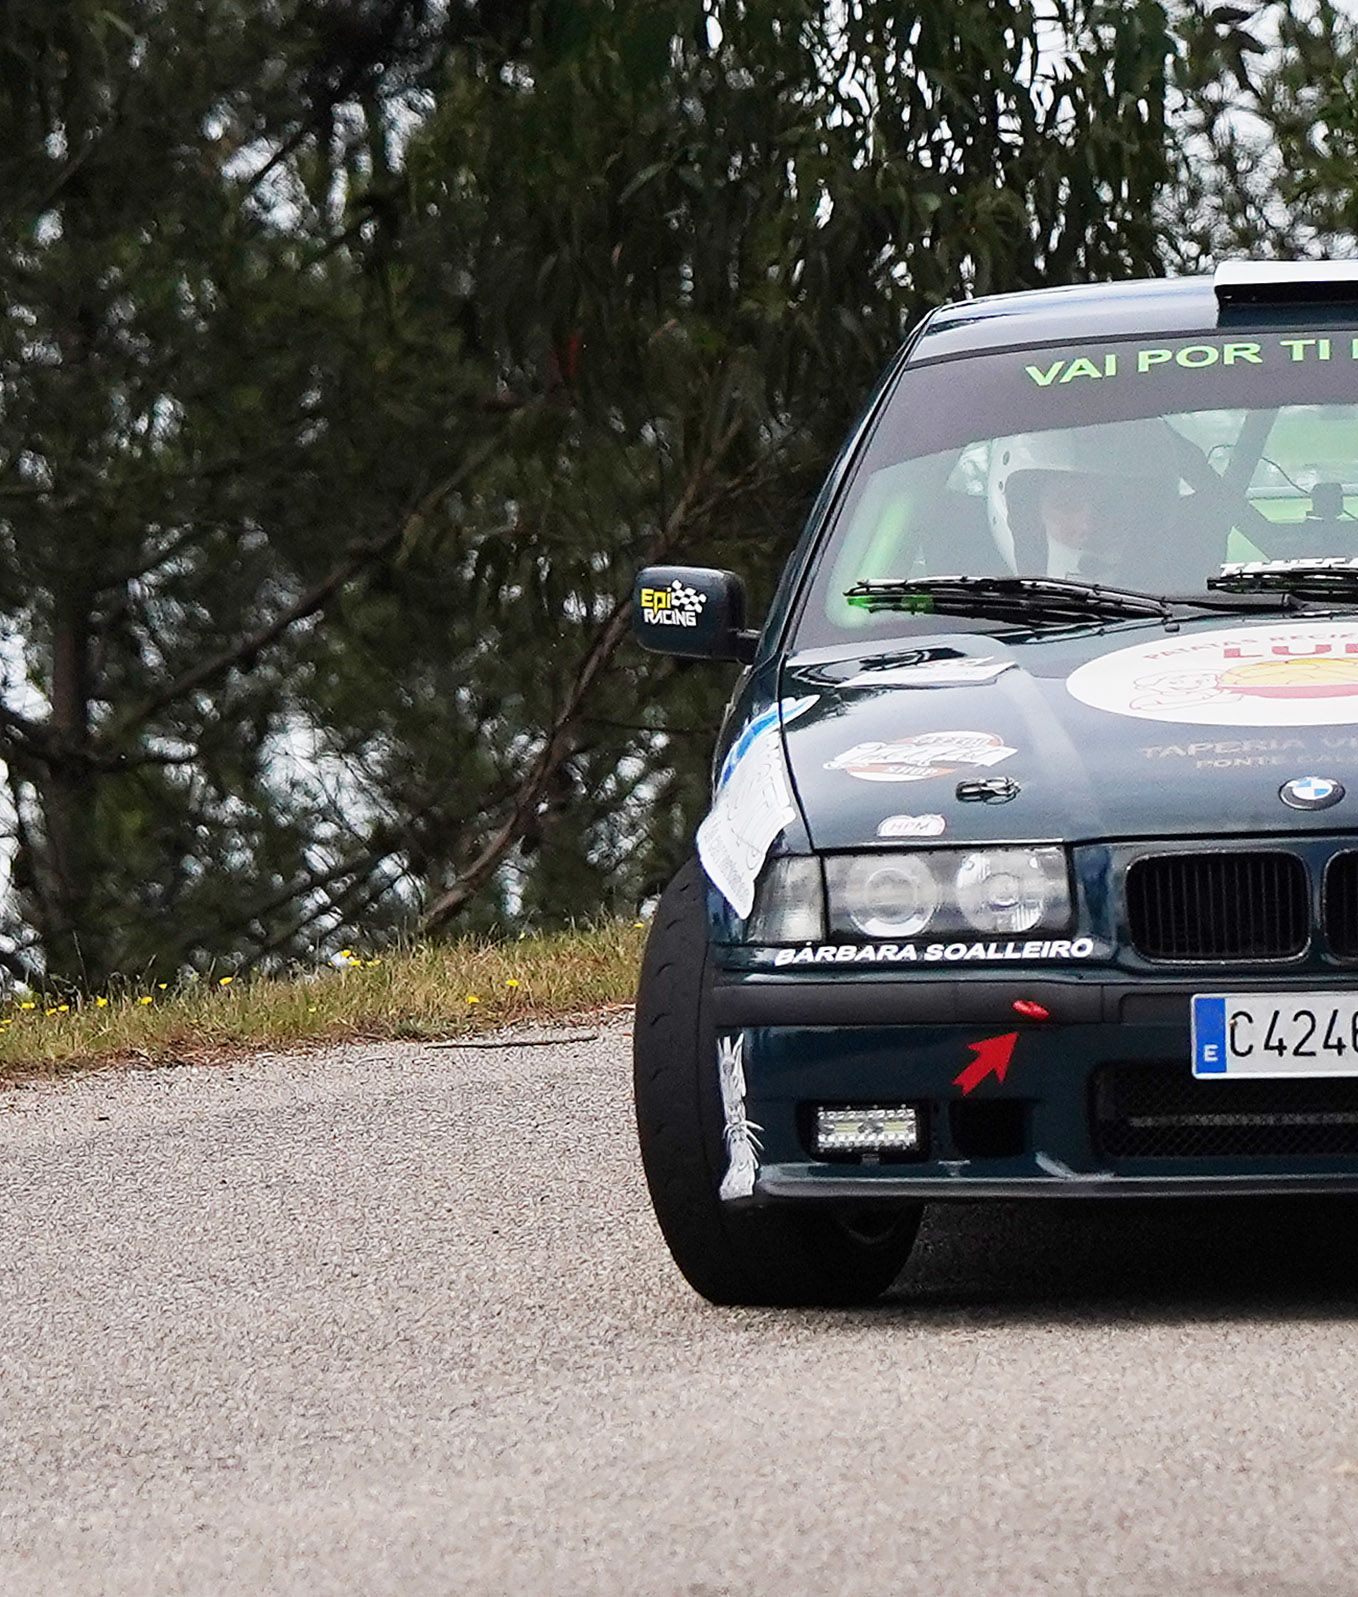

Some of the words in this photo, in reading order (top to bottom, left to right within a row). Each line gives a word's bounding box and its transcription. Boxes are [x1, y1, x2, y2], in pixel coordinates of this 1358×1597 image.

[1025, 353, 1117, 388] VAI
[1137, 342, 1263, 373] POR
[1280, 338, 1331, 361] TI
[643, 608, 697, 627] RACING
[774, 940, 918, 968] BÁRBARA
[924, 937, 1095, 963] SOALLEIRO
[1203, 1044, 1219, 1063] E
